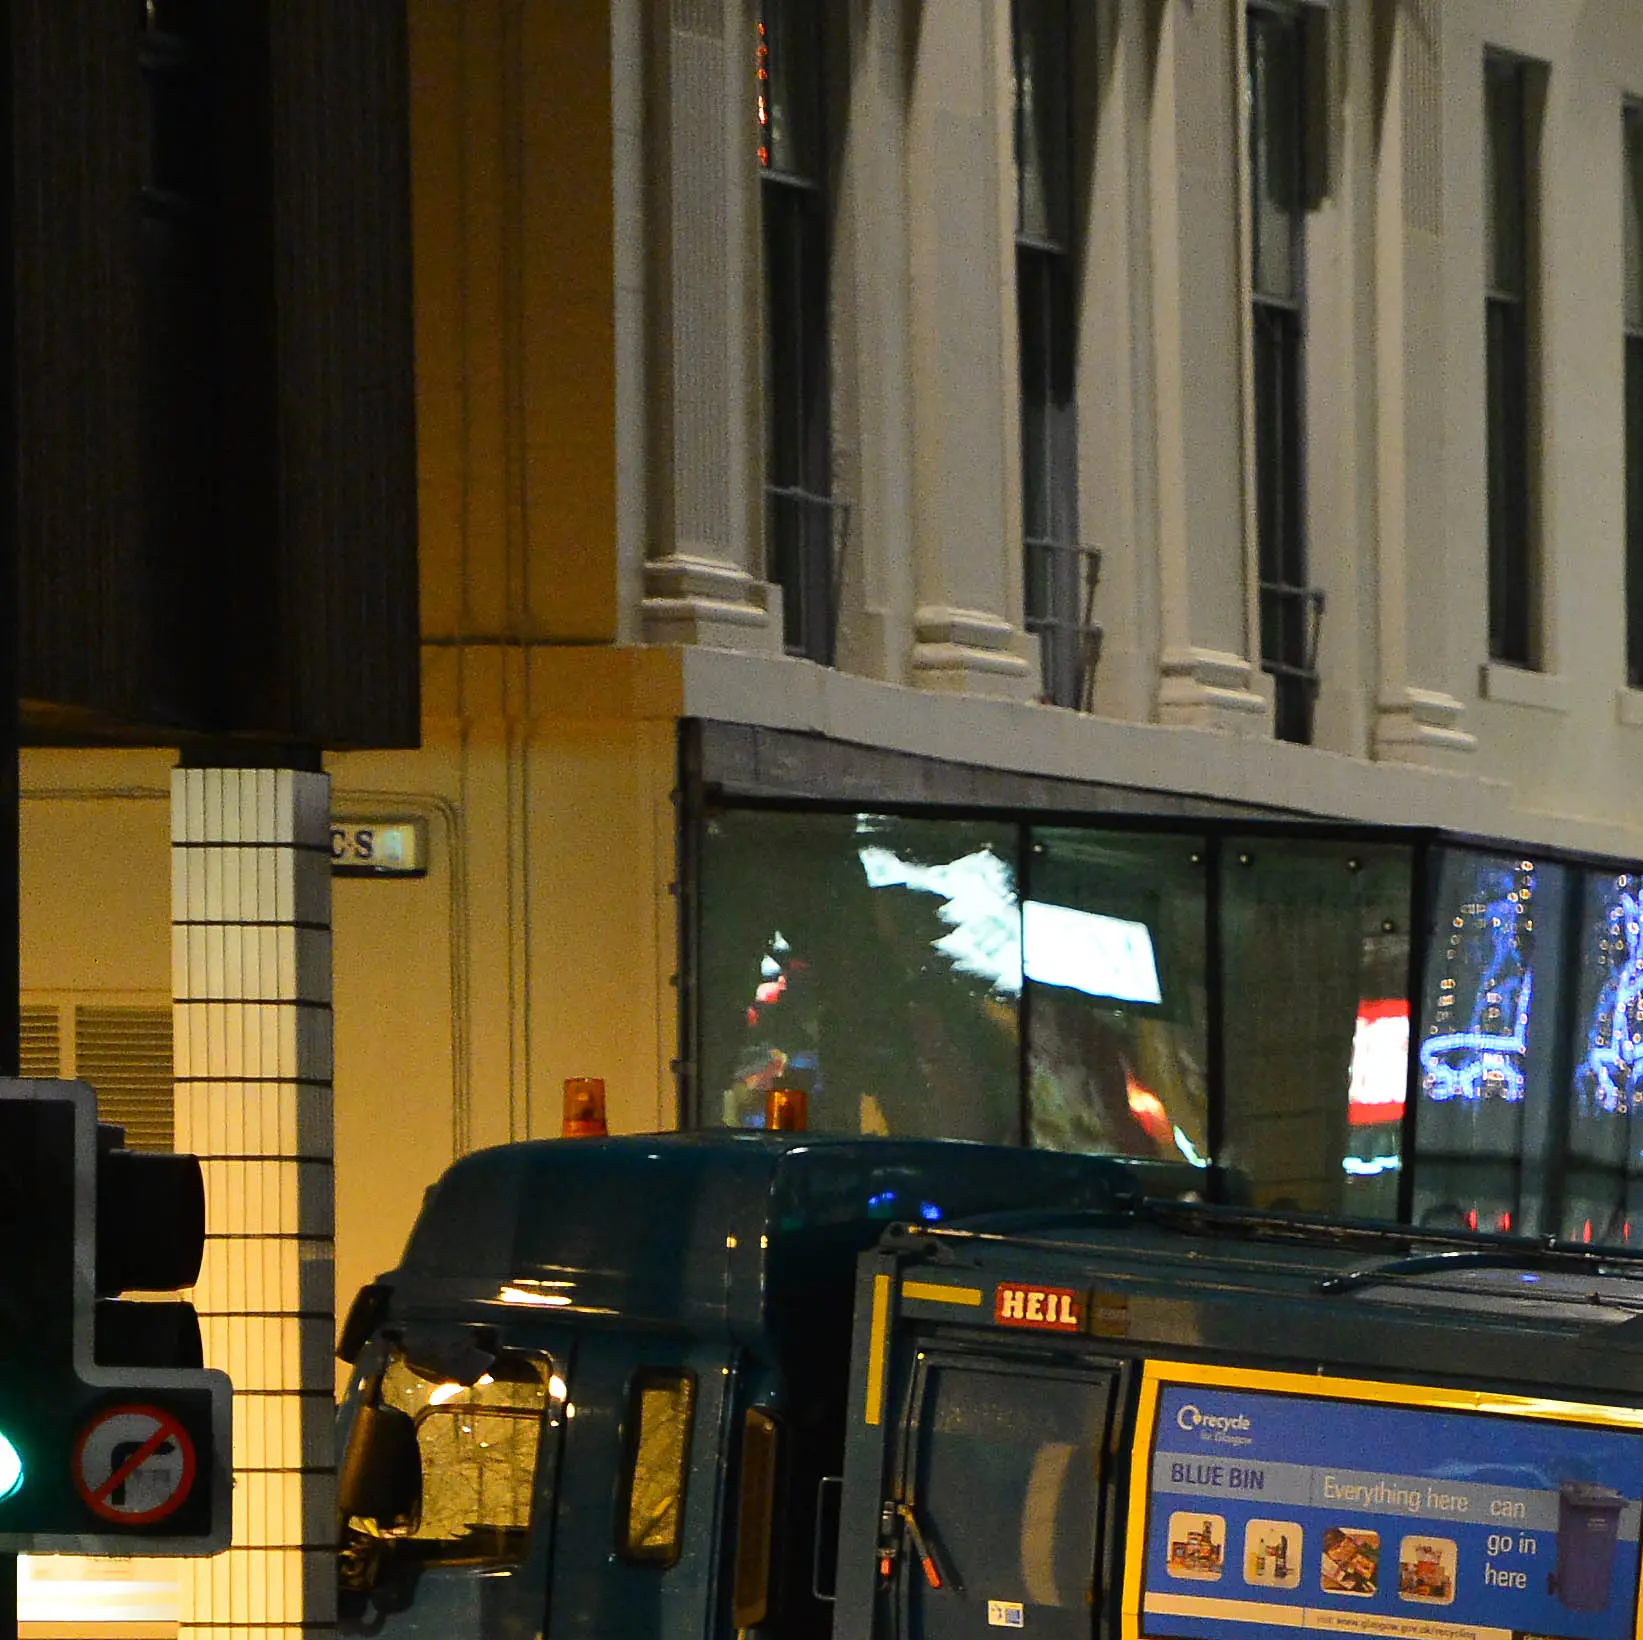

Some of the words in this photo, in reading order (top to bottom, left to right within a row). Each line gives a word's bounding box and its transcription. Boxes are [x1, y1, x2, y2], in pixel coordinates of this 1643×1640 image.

[1001, 1289, 1078, 1325] HEIL
[1202, 1413, 1252, 1432] recycle
[1170, 1462, 1224, 1487] BLUE
[1229, 1467, 1265, 1491] BIN
[1323, 1475, 1422, 1513] Everything
[1427, 1486, 1469, 1513] here
[1489, 1497, 1527, 1520] can
[1486, 1533, 1514, 1557] go
[1518, 1531, 1537, 1555] in
[1484, 1562, 1528, 1589] here
